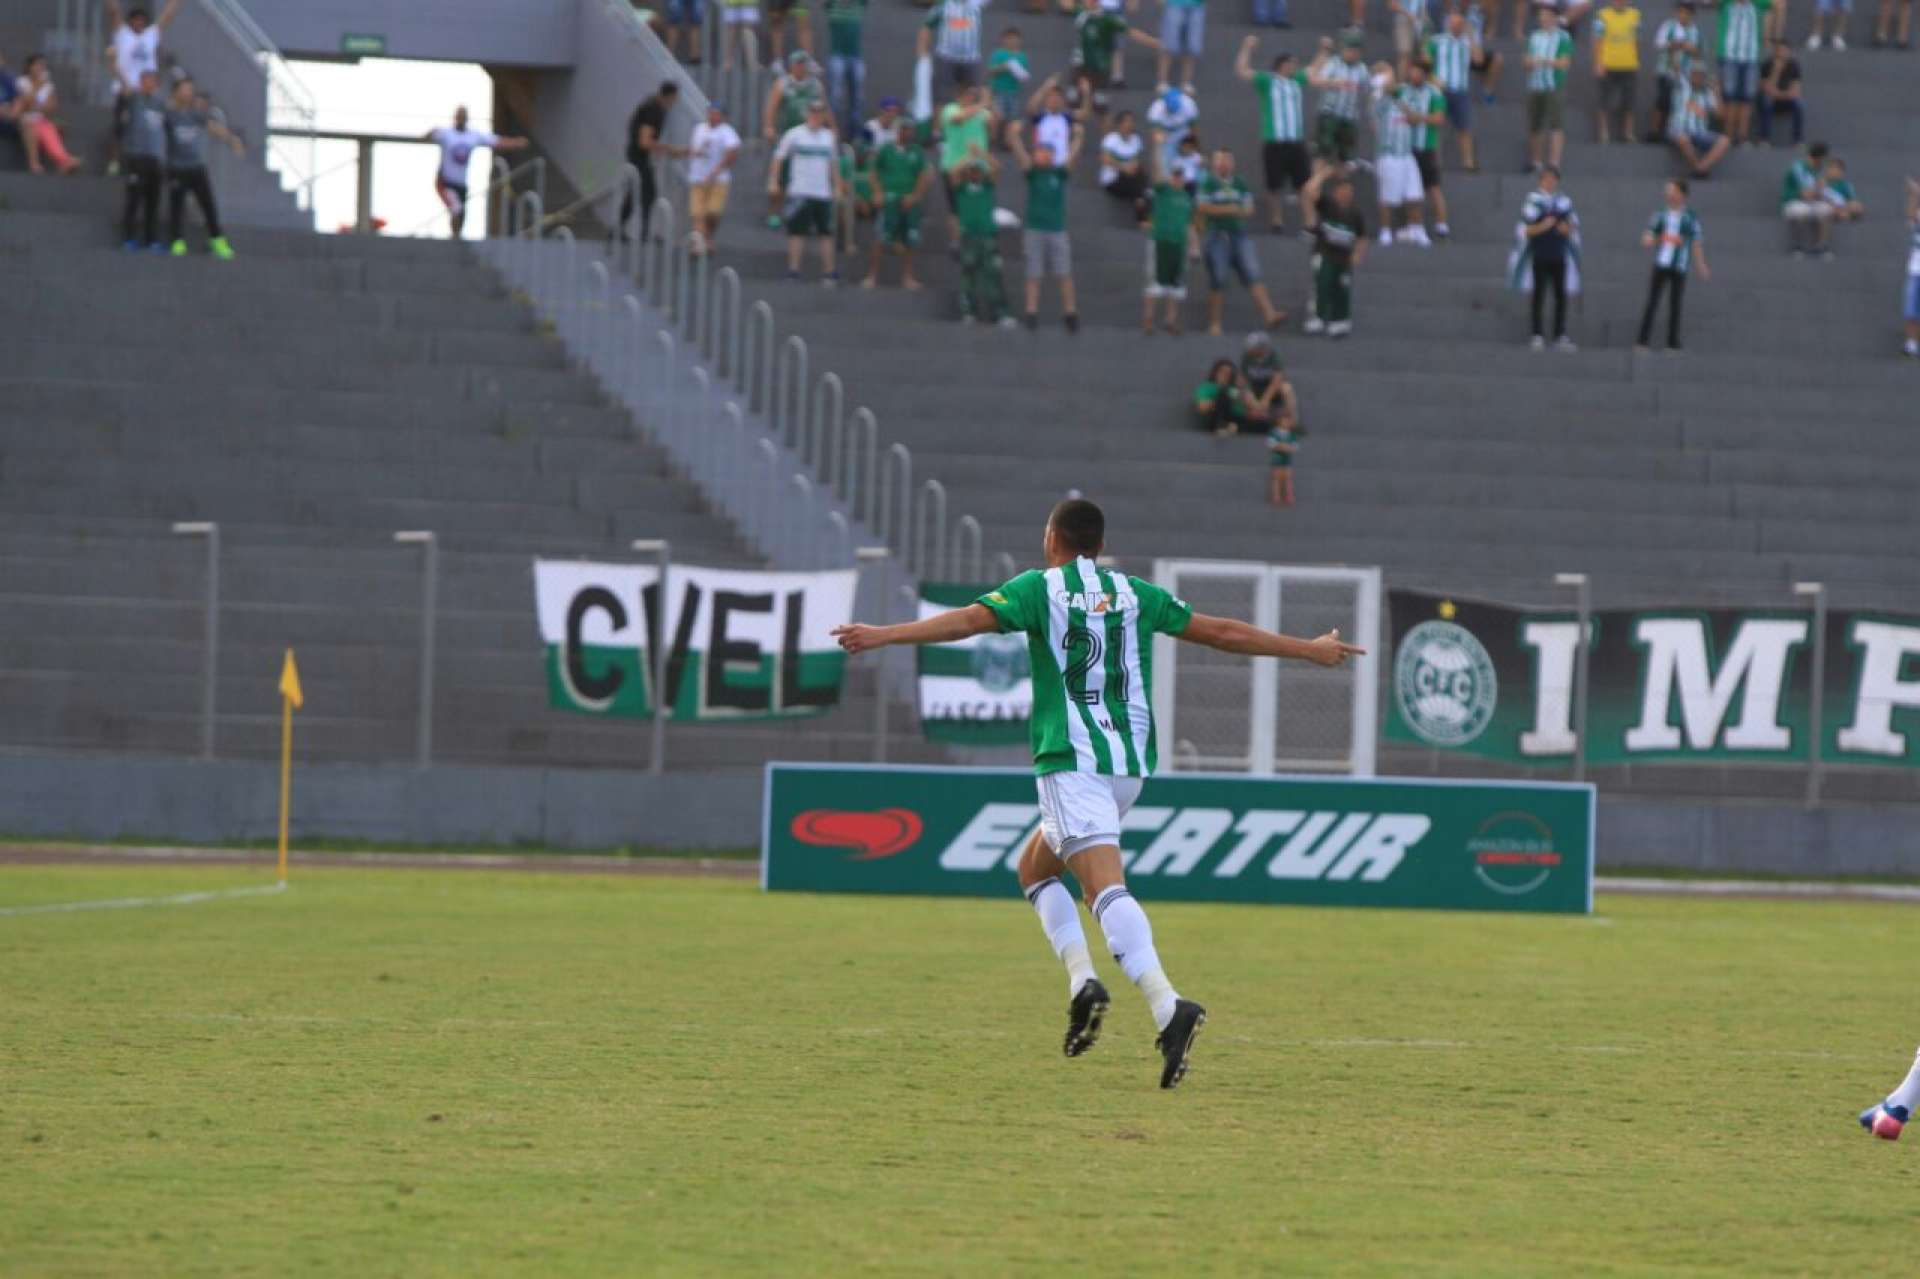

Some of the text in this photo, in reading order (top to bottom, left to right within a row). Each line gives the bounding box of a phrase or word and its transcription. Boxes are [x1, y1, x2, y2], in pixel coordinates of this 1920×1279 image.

[563, 579, 841, 709] CVEL
[1062, 625, 1129, 705] 21
[939, 802, 1431, 881] ECATUR
